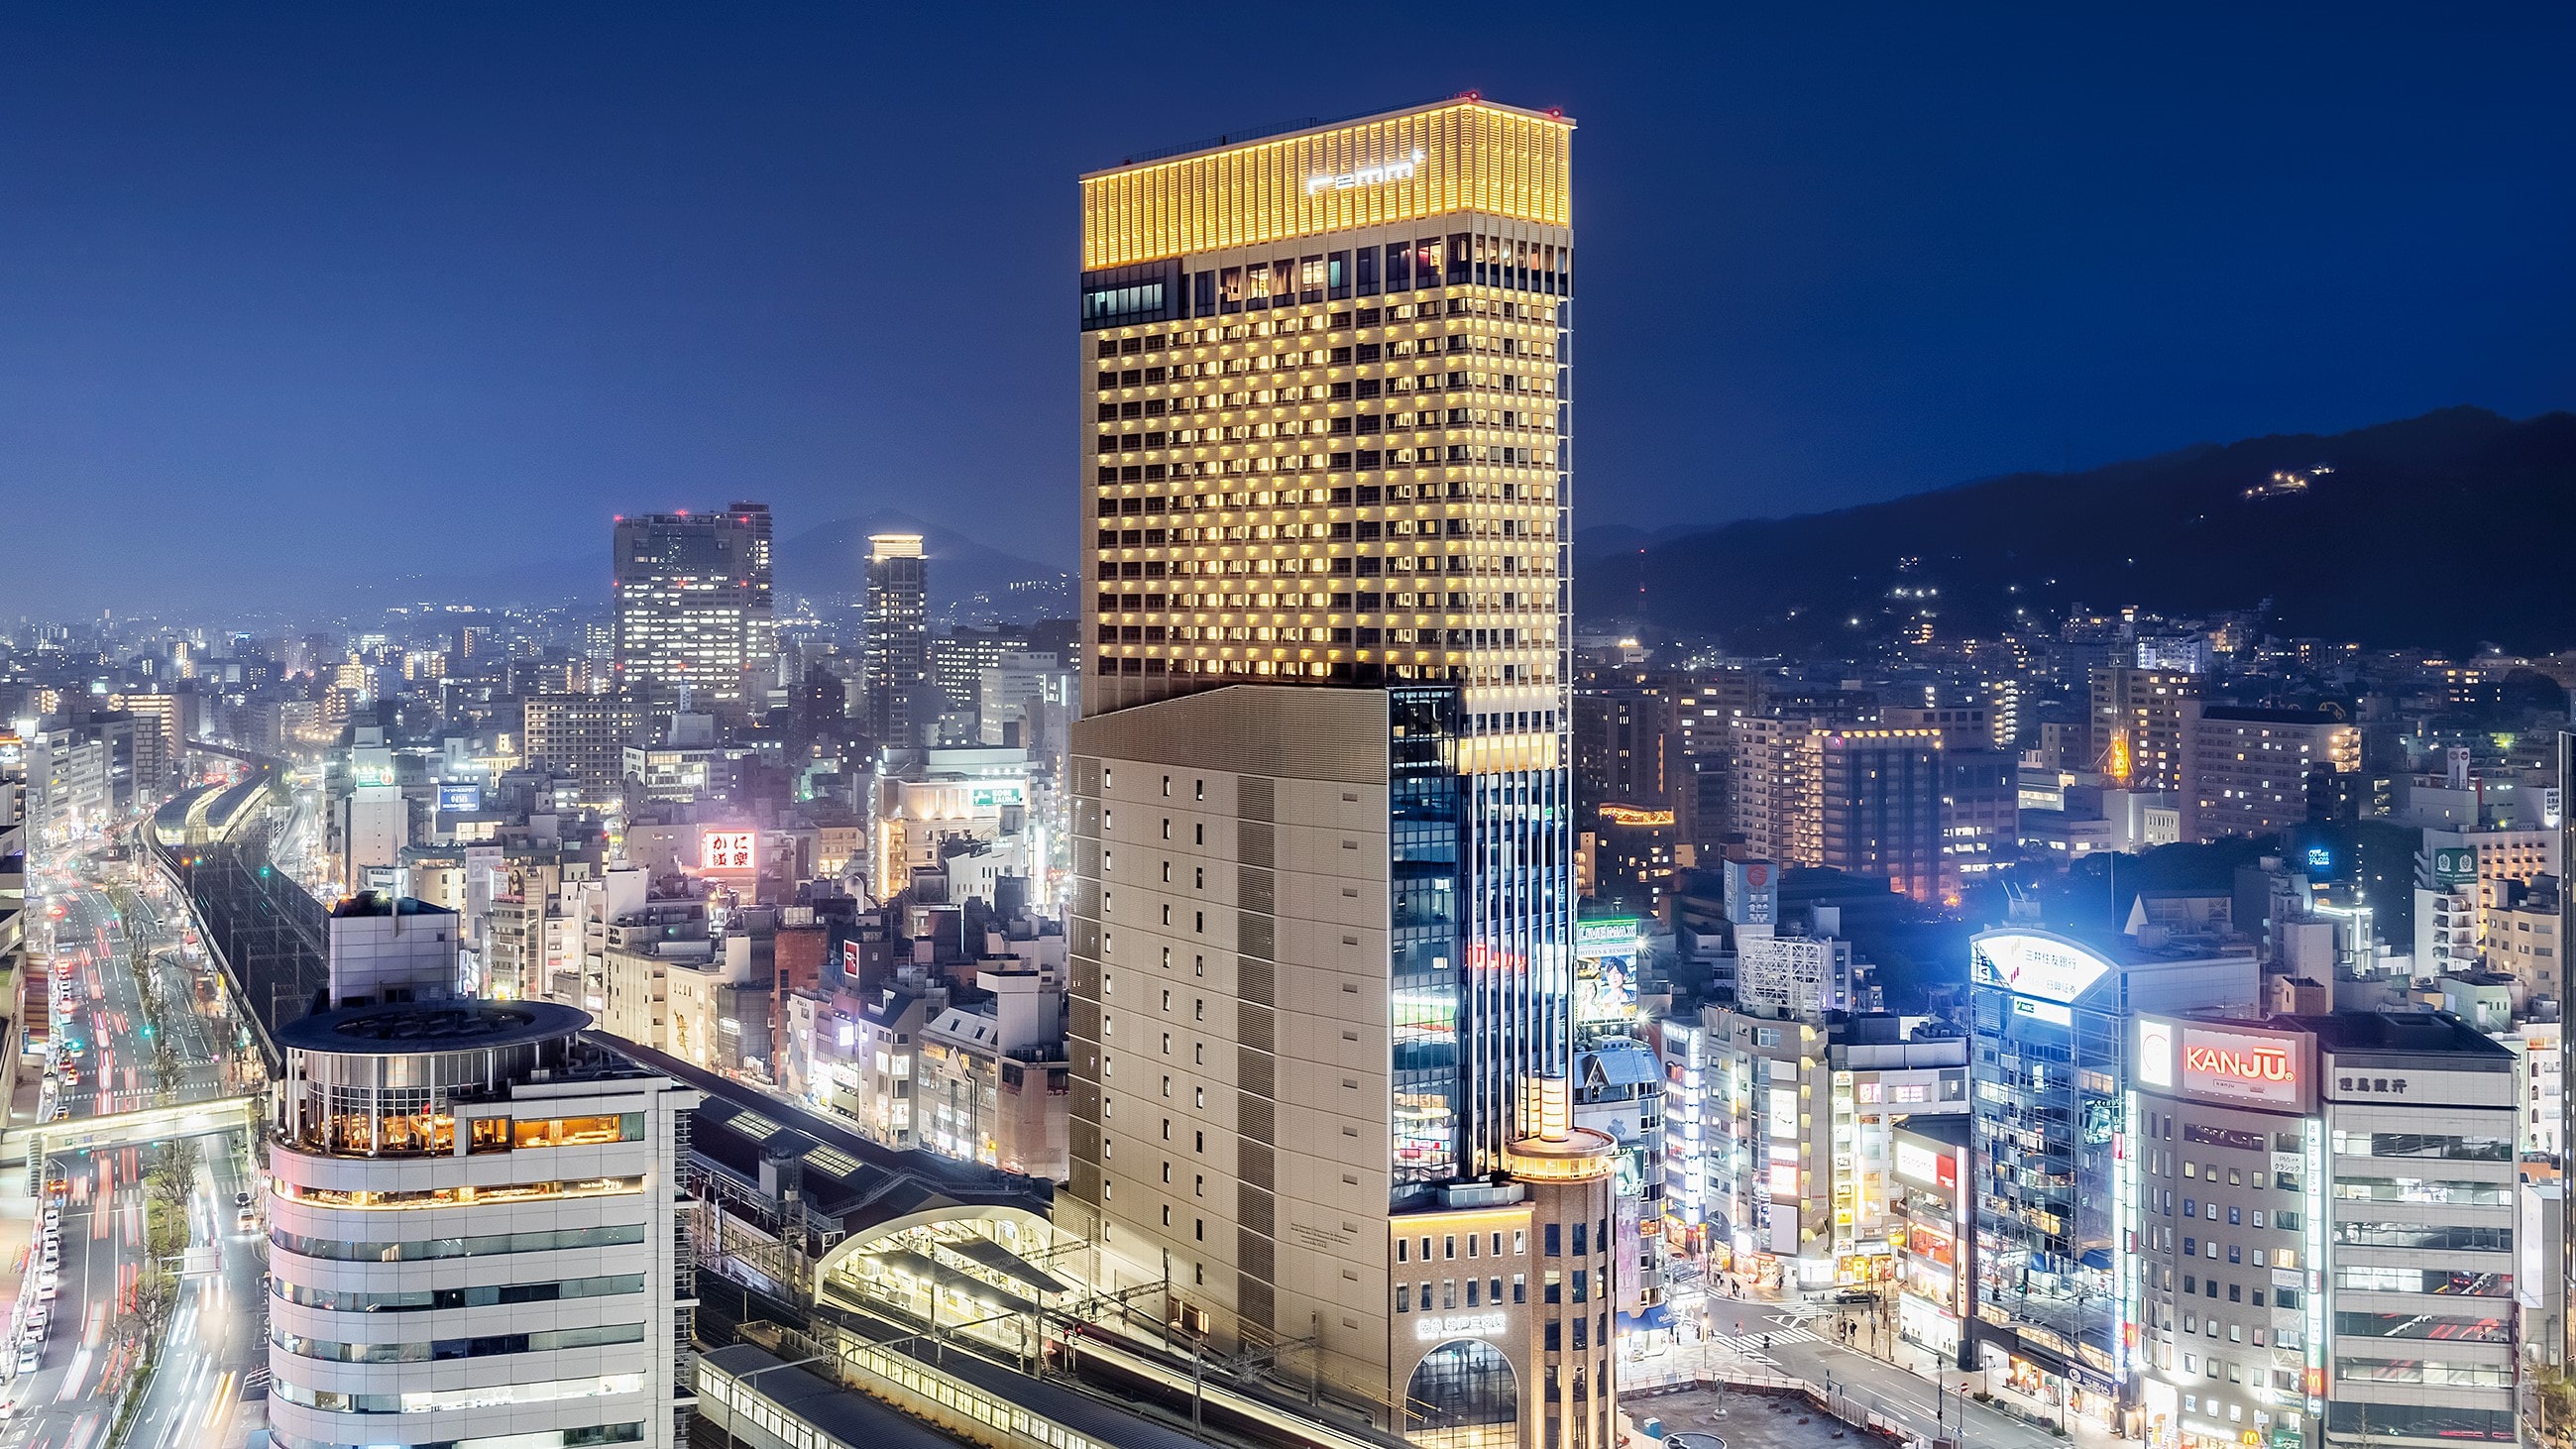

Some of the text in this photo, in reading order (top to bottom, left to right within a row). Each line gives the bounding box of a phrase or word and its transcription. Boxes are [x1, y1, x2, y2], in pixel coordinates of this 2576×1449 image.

[713, 836, 749, 850] かに
[2025, 948, 2076, 970] 三井住友銀行
[2339, 1077, 2408, 1094] 但馬銀行
